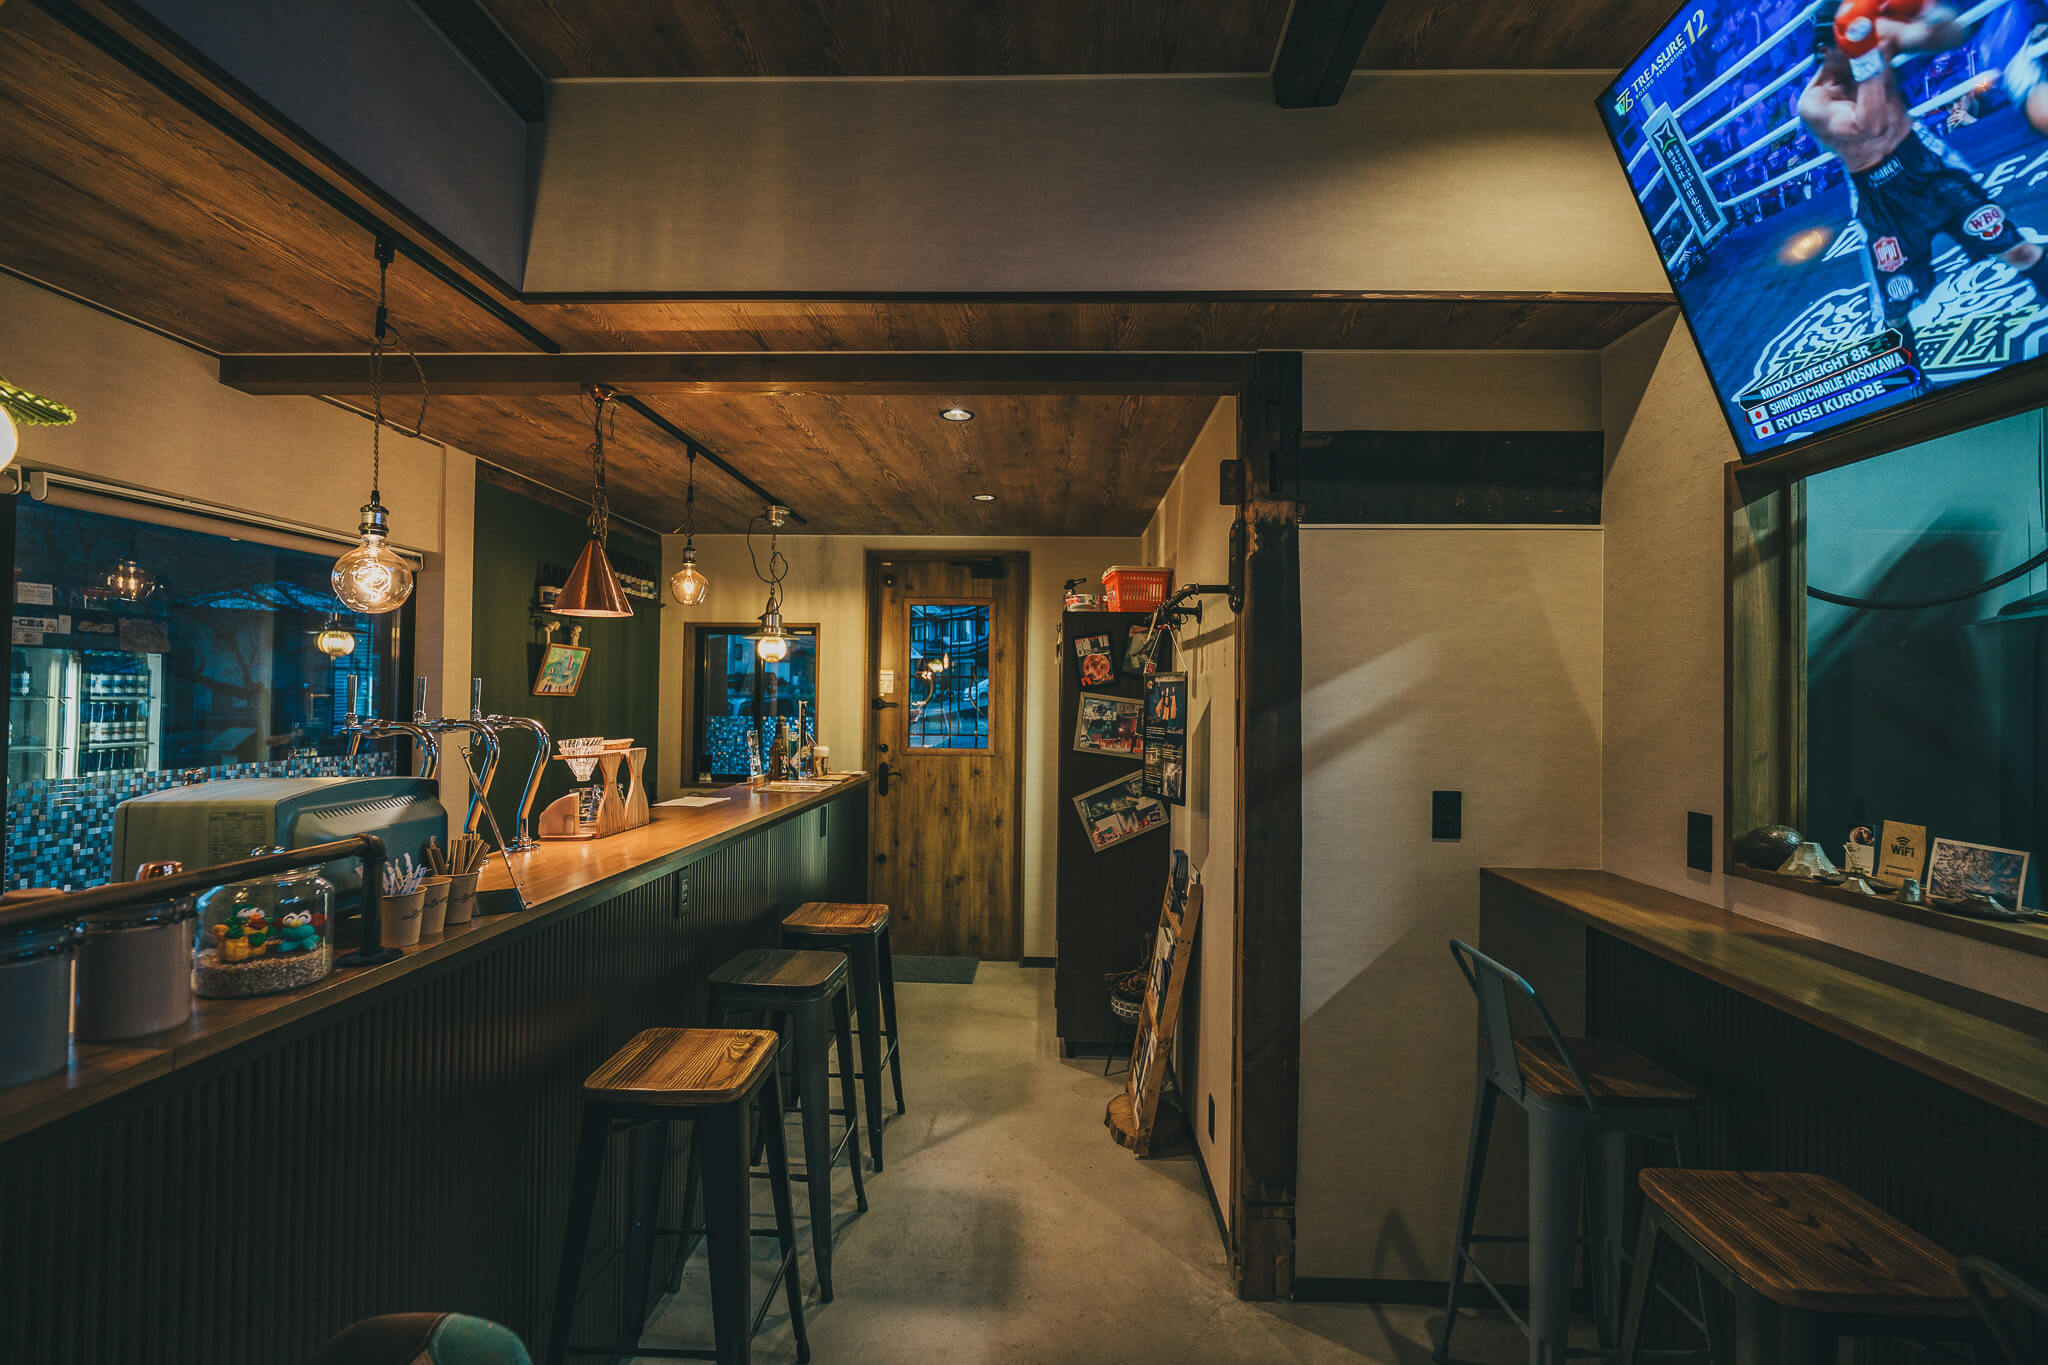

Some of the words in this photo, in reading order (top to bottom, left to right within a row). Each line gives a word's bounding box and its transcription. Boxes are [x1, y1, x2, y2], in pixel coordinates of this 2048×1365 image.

[1631, 33, 1685, 92] TREASURE
[1683, 9, 1708, 44] 12
[1656, 44, 1687, 77] PROMOTION
[1760, 353, 1850, 400] MIDDLEWEIGHT
[1851, 344, 1873, 362] 8R
[1769, 392, 1807, 415] SHINOBU
[1805, 376, 1846, 402] CHARLIE
[1845, 351, 1906, 386] HOSOKAWA
[1776, 404, 1824, 431] RYUSEI
[1823, 380, 1887, 414] KUROBE
